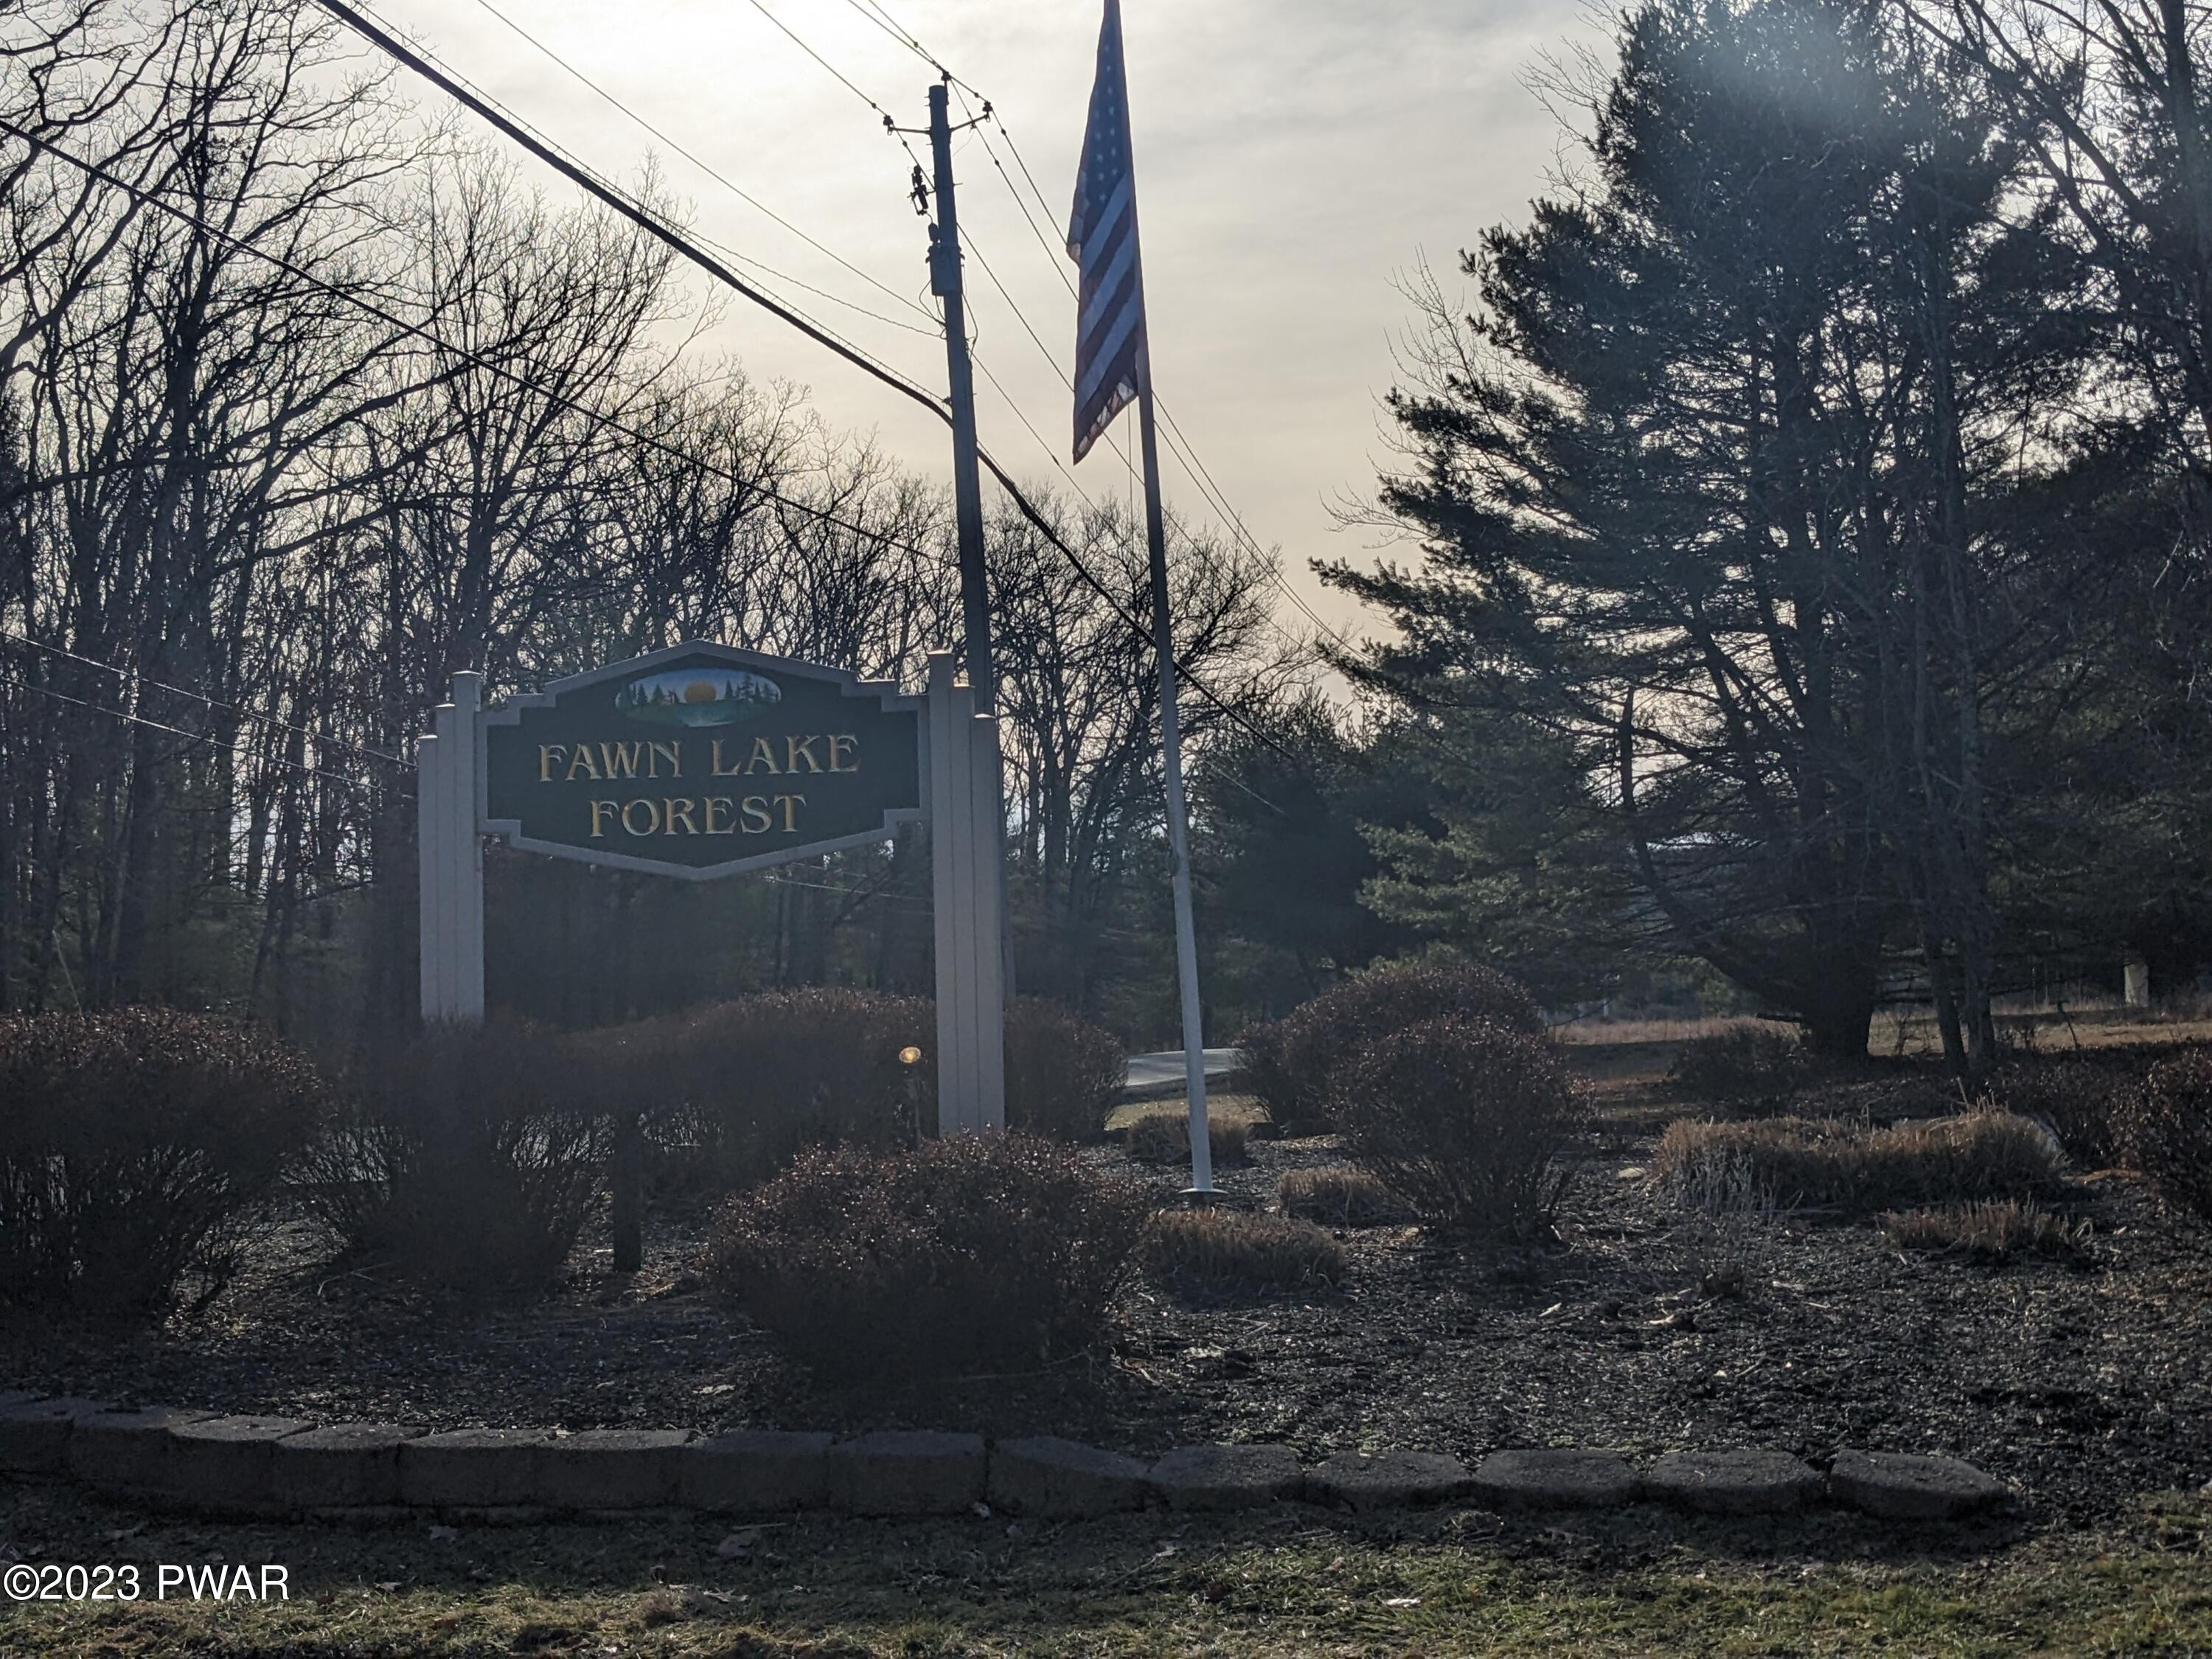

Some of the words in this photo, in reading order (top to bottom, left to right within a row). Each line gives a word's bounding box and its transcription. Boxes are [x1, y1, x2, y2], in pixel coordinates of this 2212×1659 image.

[538, 740, 681, 782] FAWN
[711, 734, 861, 776] LAKE
[590, 794, 807, 838] FOREST
